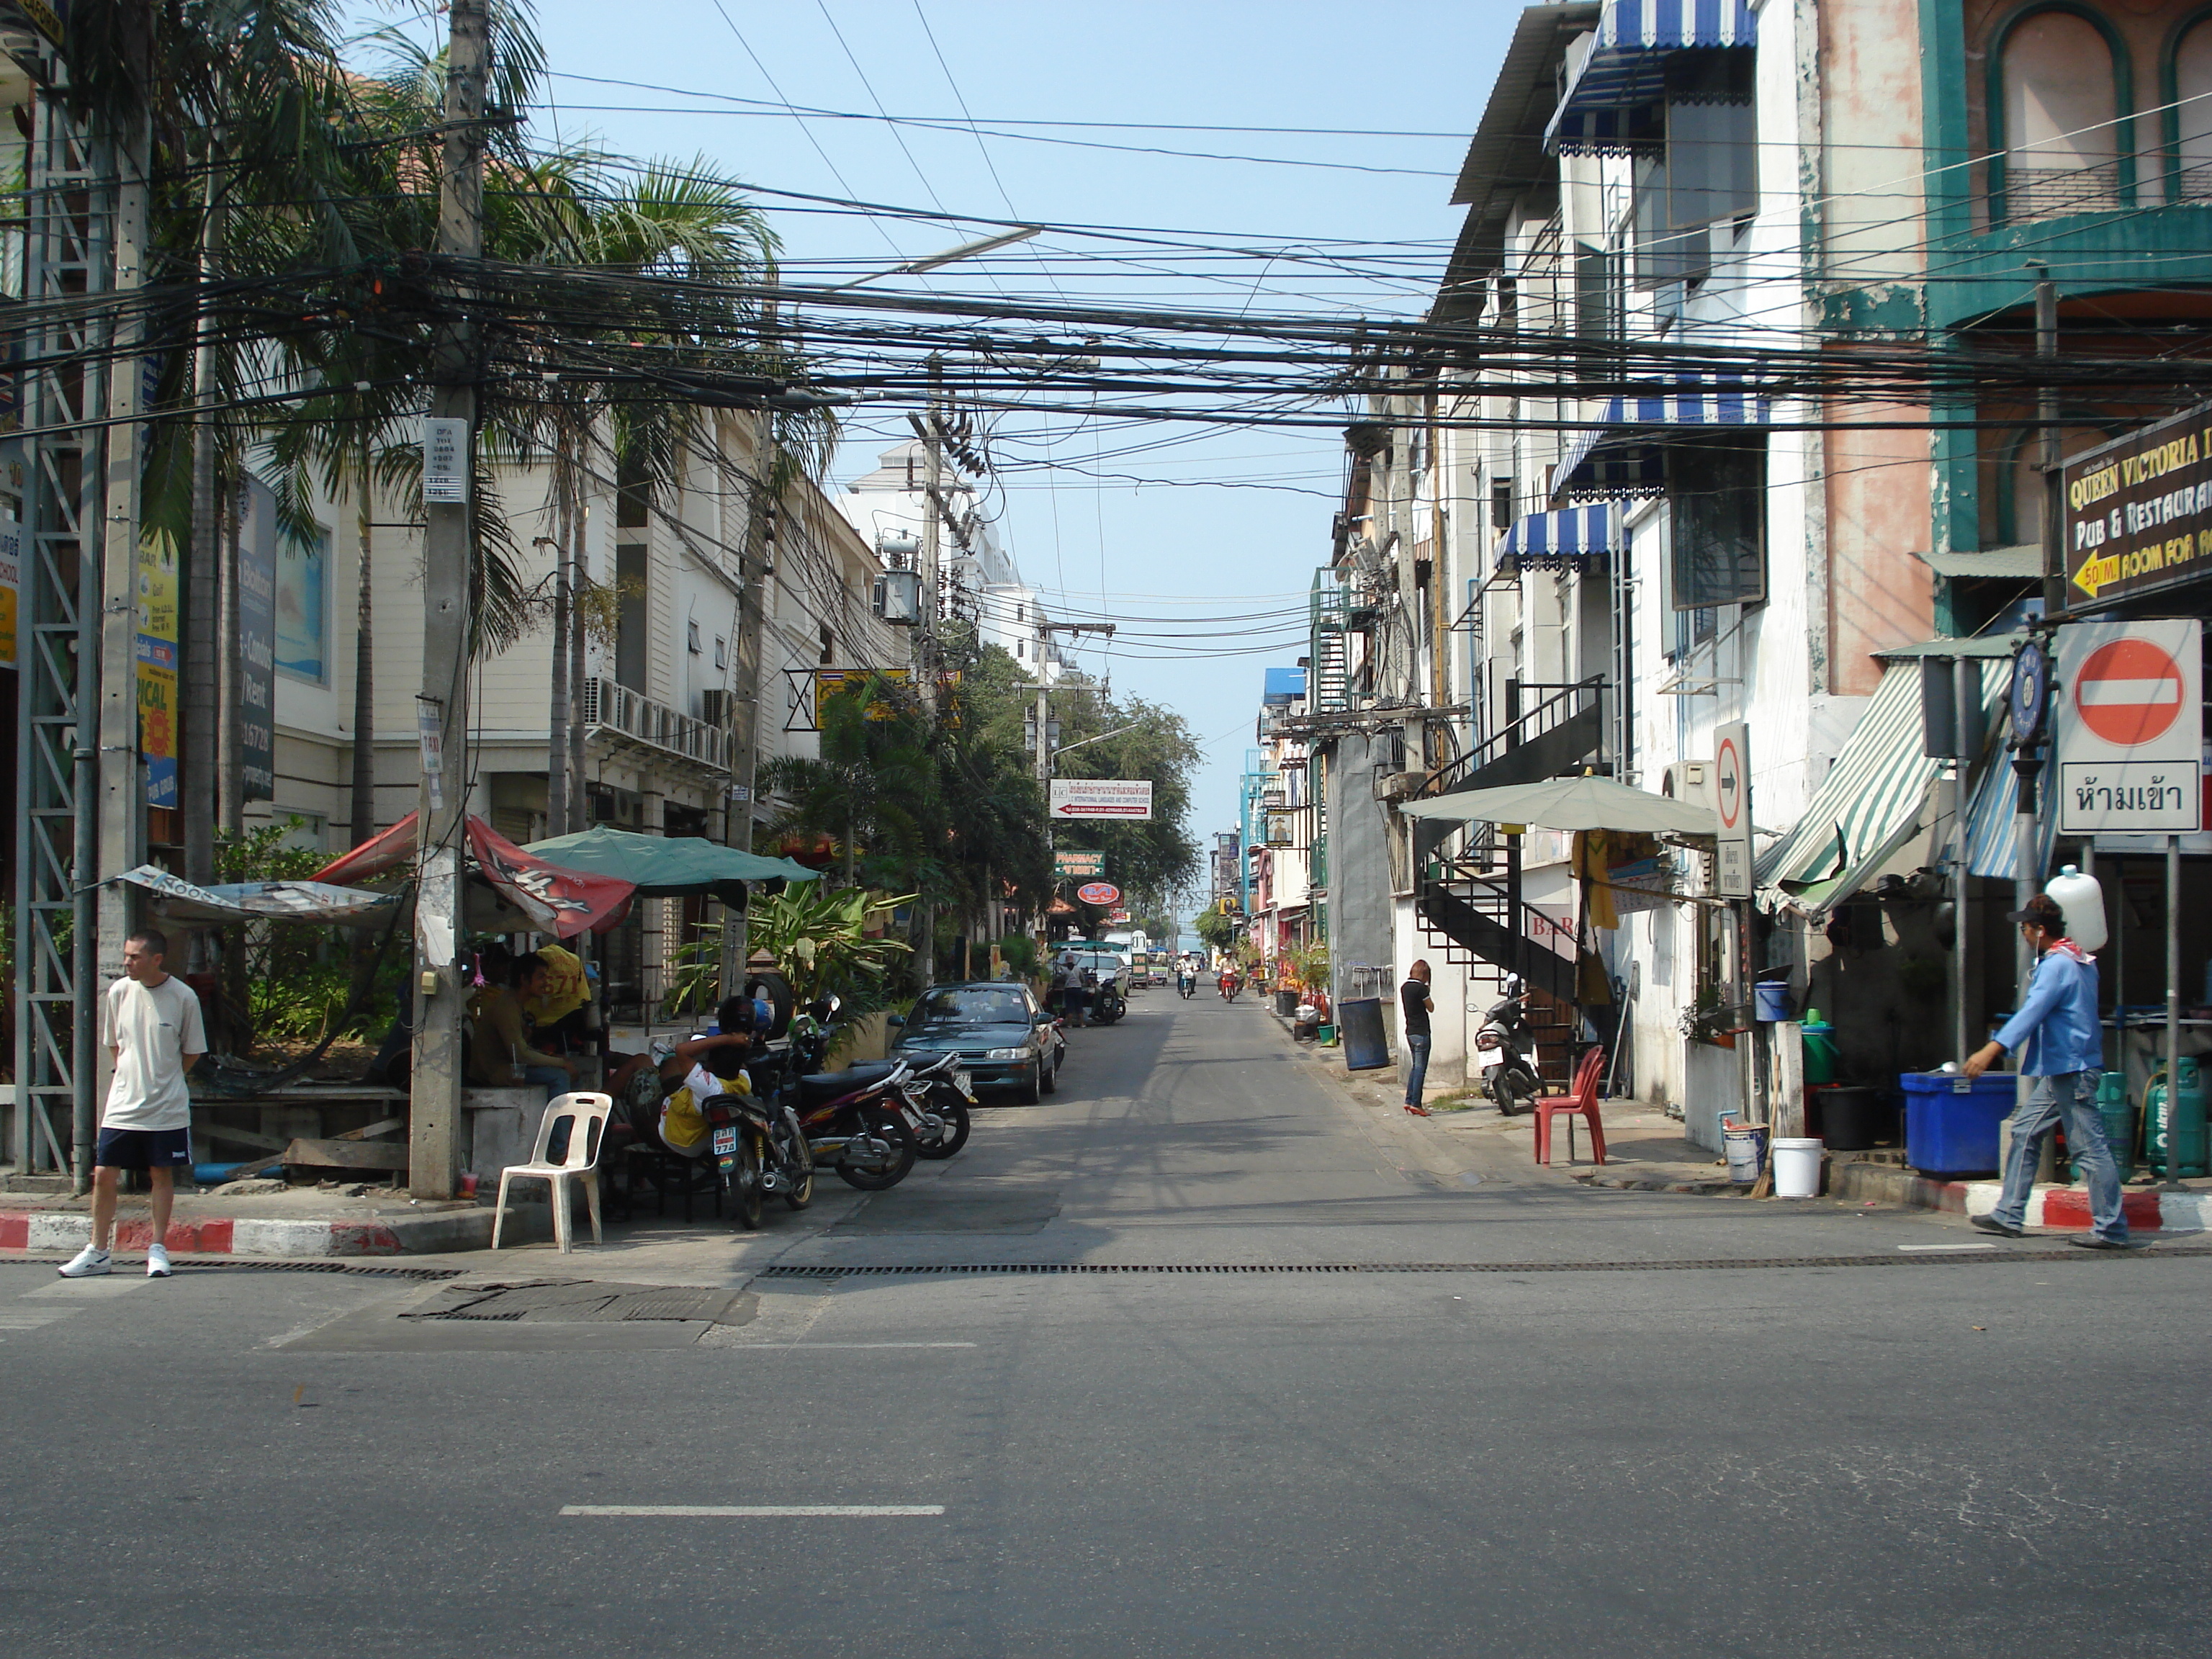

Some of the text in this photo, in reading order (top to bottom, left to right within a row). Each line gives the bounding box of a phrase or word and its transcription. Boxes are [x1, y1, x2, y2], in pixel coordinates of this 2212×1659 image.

[2070, 462, 2120, 512] QUEEN
[2121, 433, 2200, 487] VICTORIA
[2109, 508, 2122, 539] &
[2085, 566, 2099, 586] 50
[2122, 543, 2163, 580] ROOM
[2164, 533, 2195, 567] FOR
[2075, 775, 2182, 811] ห้ามเข้า
[1056, 853, 1103, 863] PHARMACY
[1532, 917, 1573, 935] BAR
